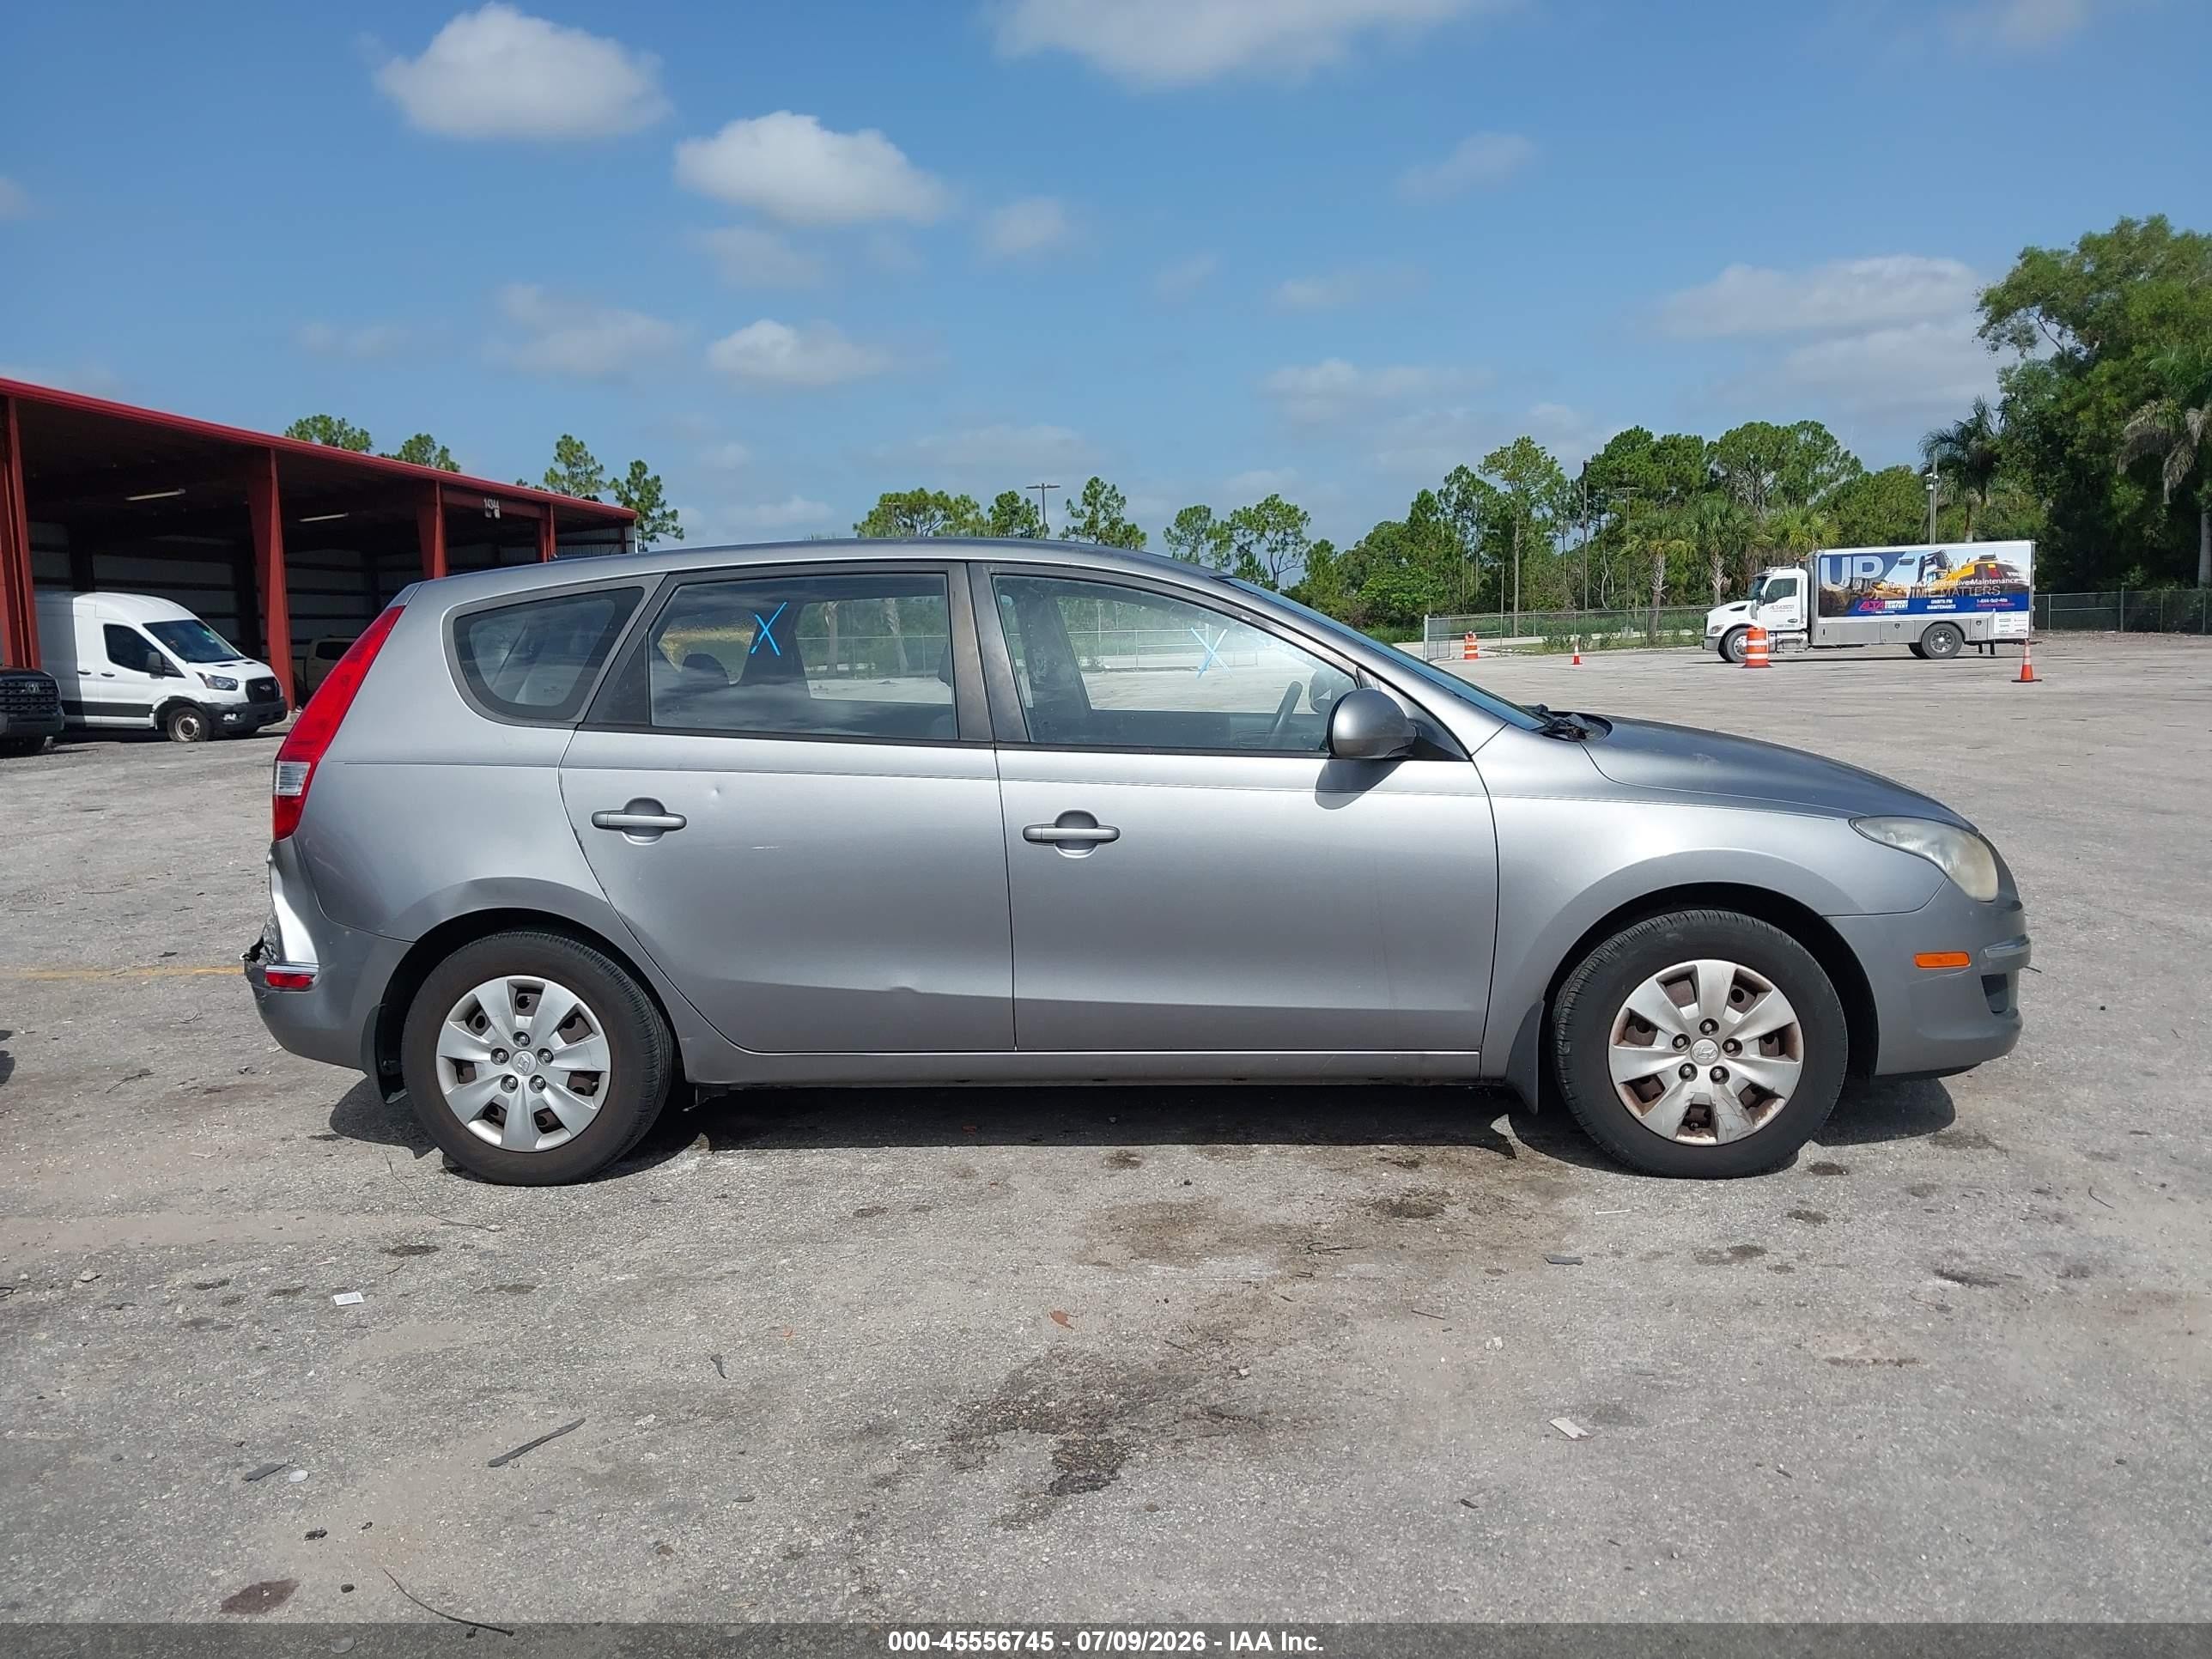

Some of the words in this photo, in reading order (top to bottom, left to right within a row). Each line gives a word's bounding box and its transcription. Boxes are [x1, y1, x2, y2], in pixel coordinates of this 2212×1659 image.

[1820, 556, 1884, 592] UP
[1940, 586, 2001, 598] MATTERS
[1859, 600, 1885, 611] ALTA
